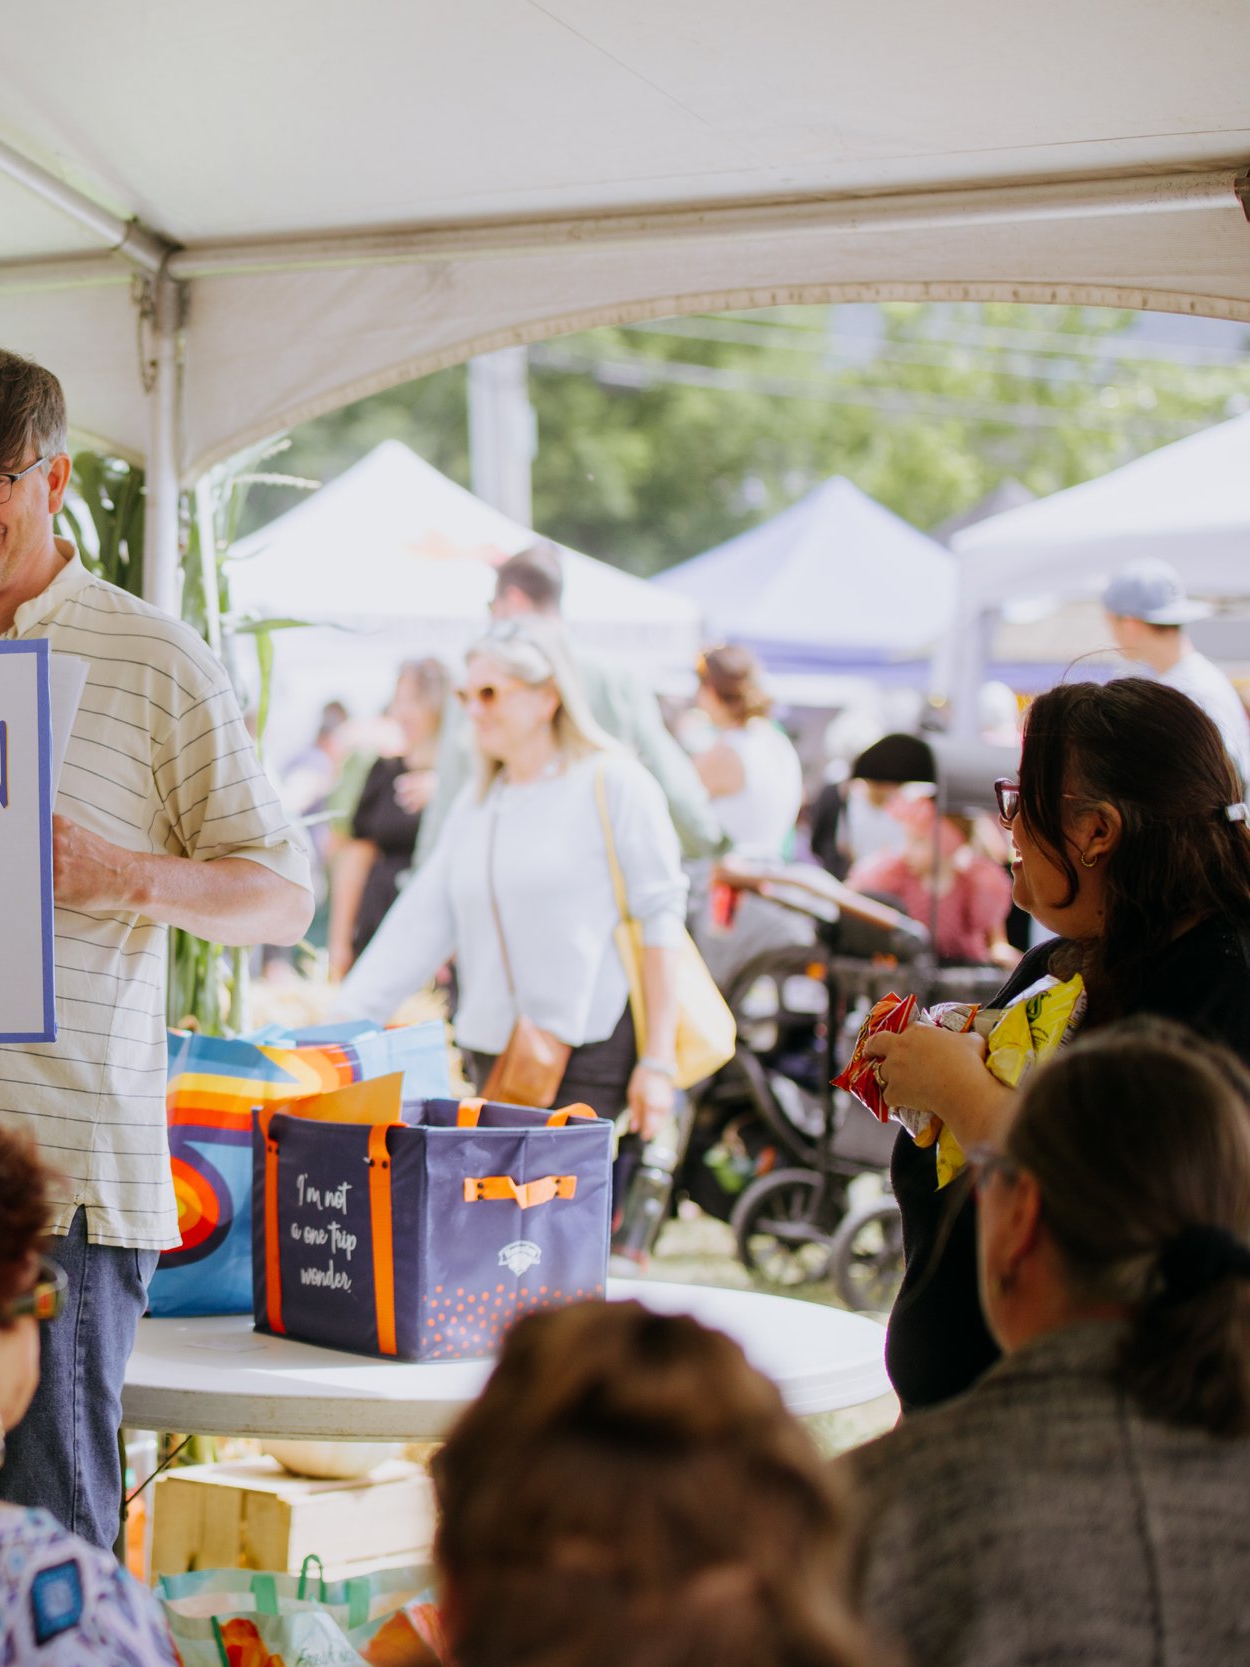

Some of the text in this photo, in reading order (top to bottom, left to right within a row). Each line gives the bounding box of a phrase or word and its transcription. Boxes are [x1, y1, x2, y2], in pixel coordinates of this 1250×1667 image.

[296, 1173, 353, 1215] I'm not
[291, 1220, 357, 1261] a one trip
